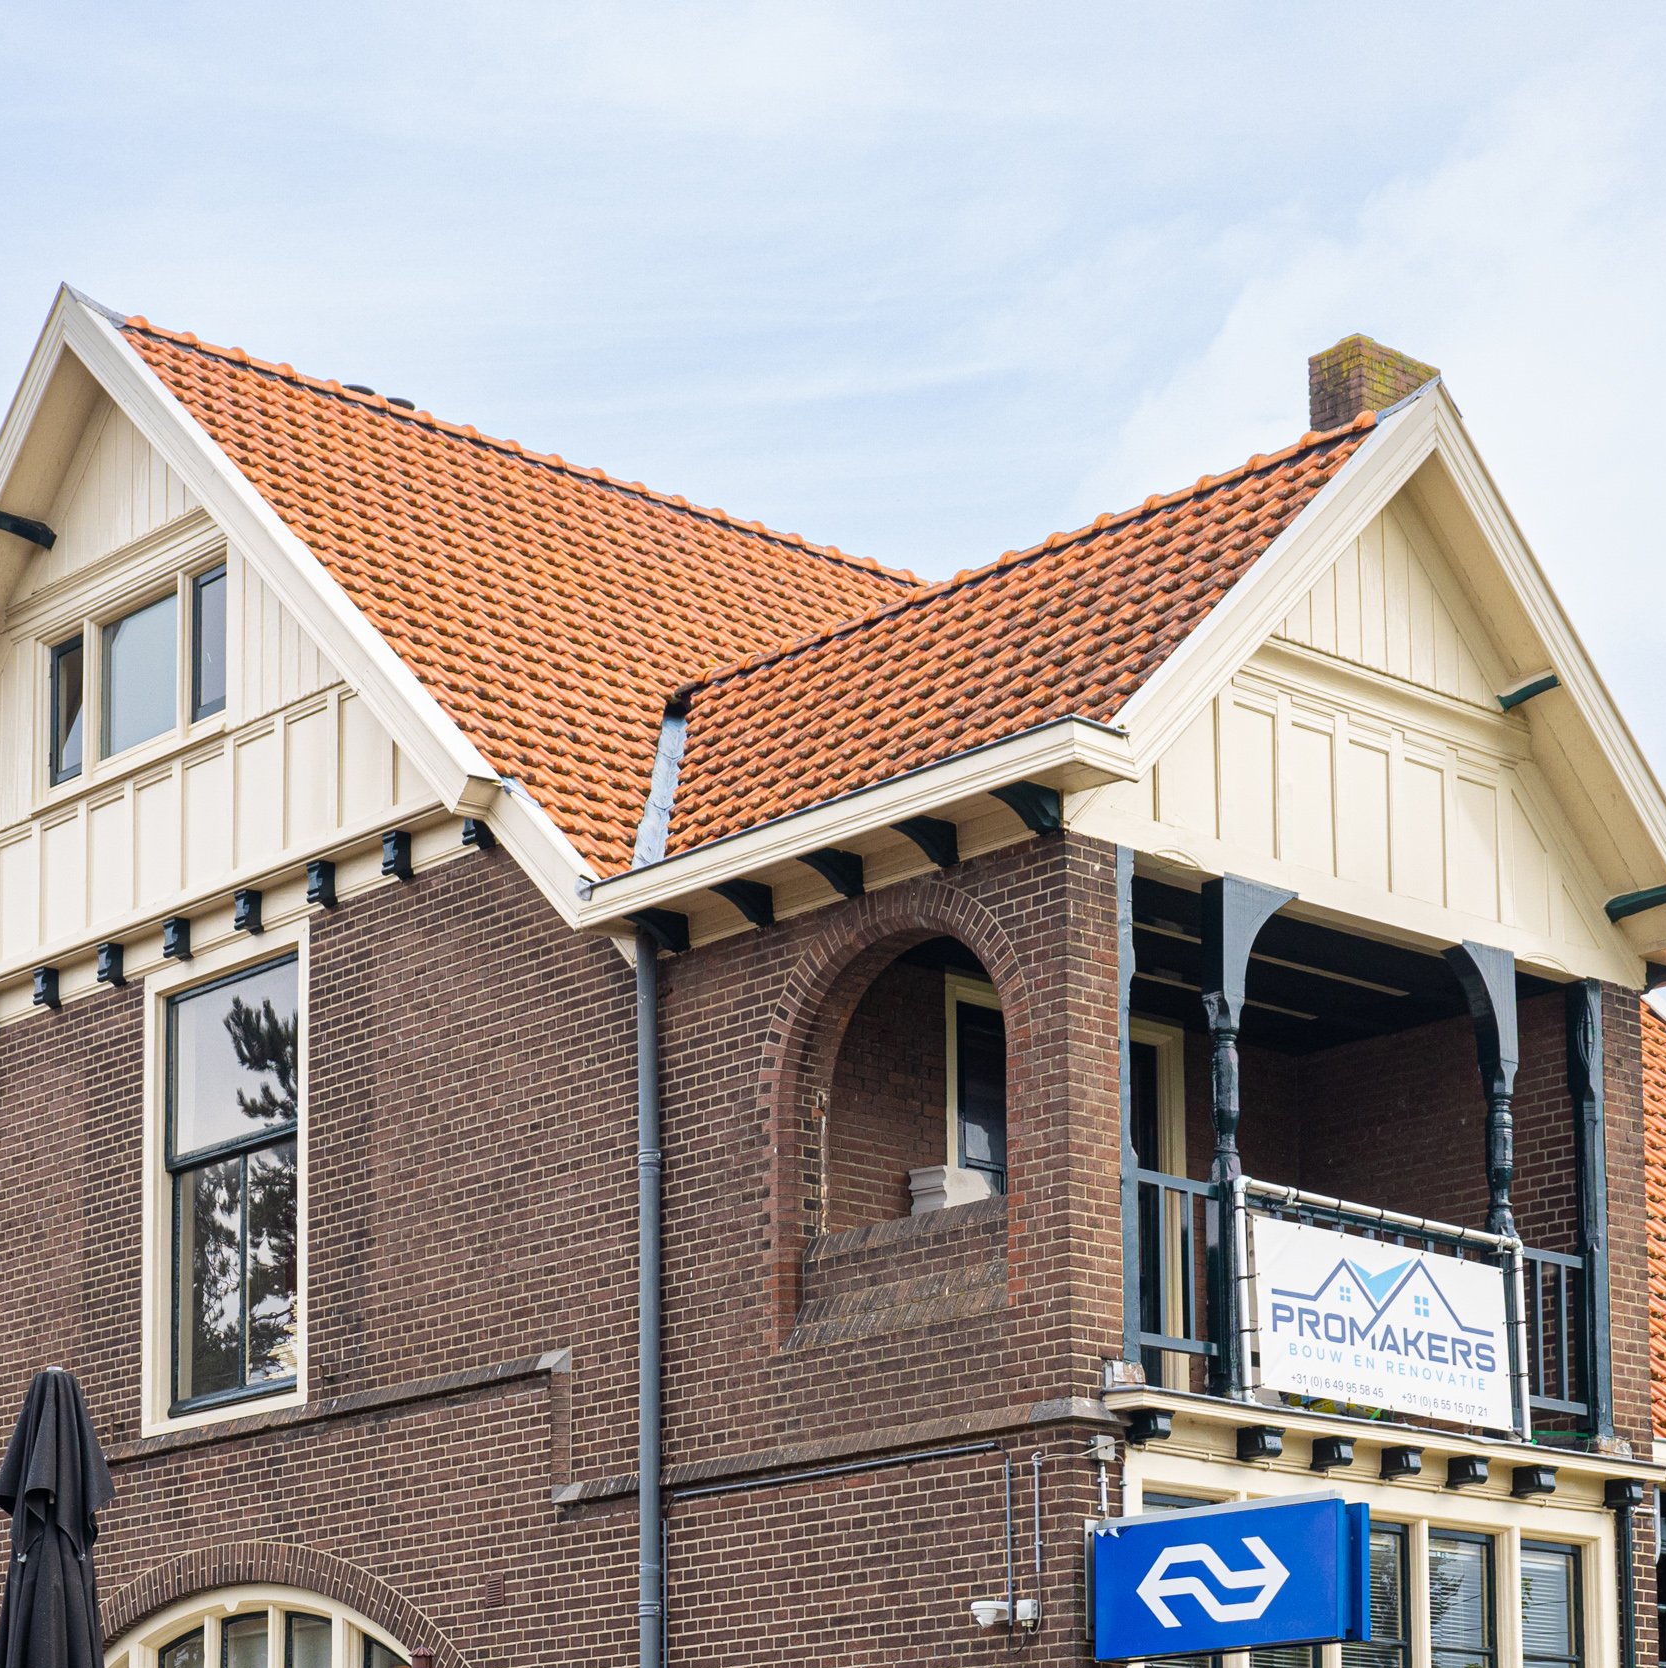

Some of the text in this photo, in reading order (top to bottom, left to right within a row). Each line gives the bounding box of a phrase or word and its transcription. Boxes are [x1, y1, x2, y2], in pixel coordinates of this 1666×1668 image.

[1271, 1302, 1496, 1373] PROMAKERS
[1289, 1342, 1487, 1391] BOUW EN RENOVATIE
[1291, 1373, 1384, 1398] +31 (0) 6 49 95 58 45
[1402, 1392, 1488, 1417] +31 (0) 6 55 15 07 21
